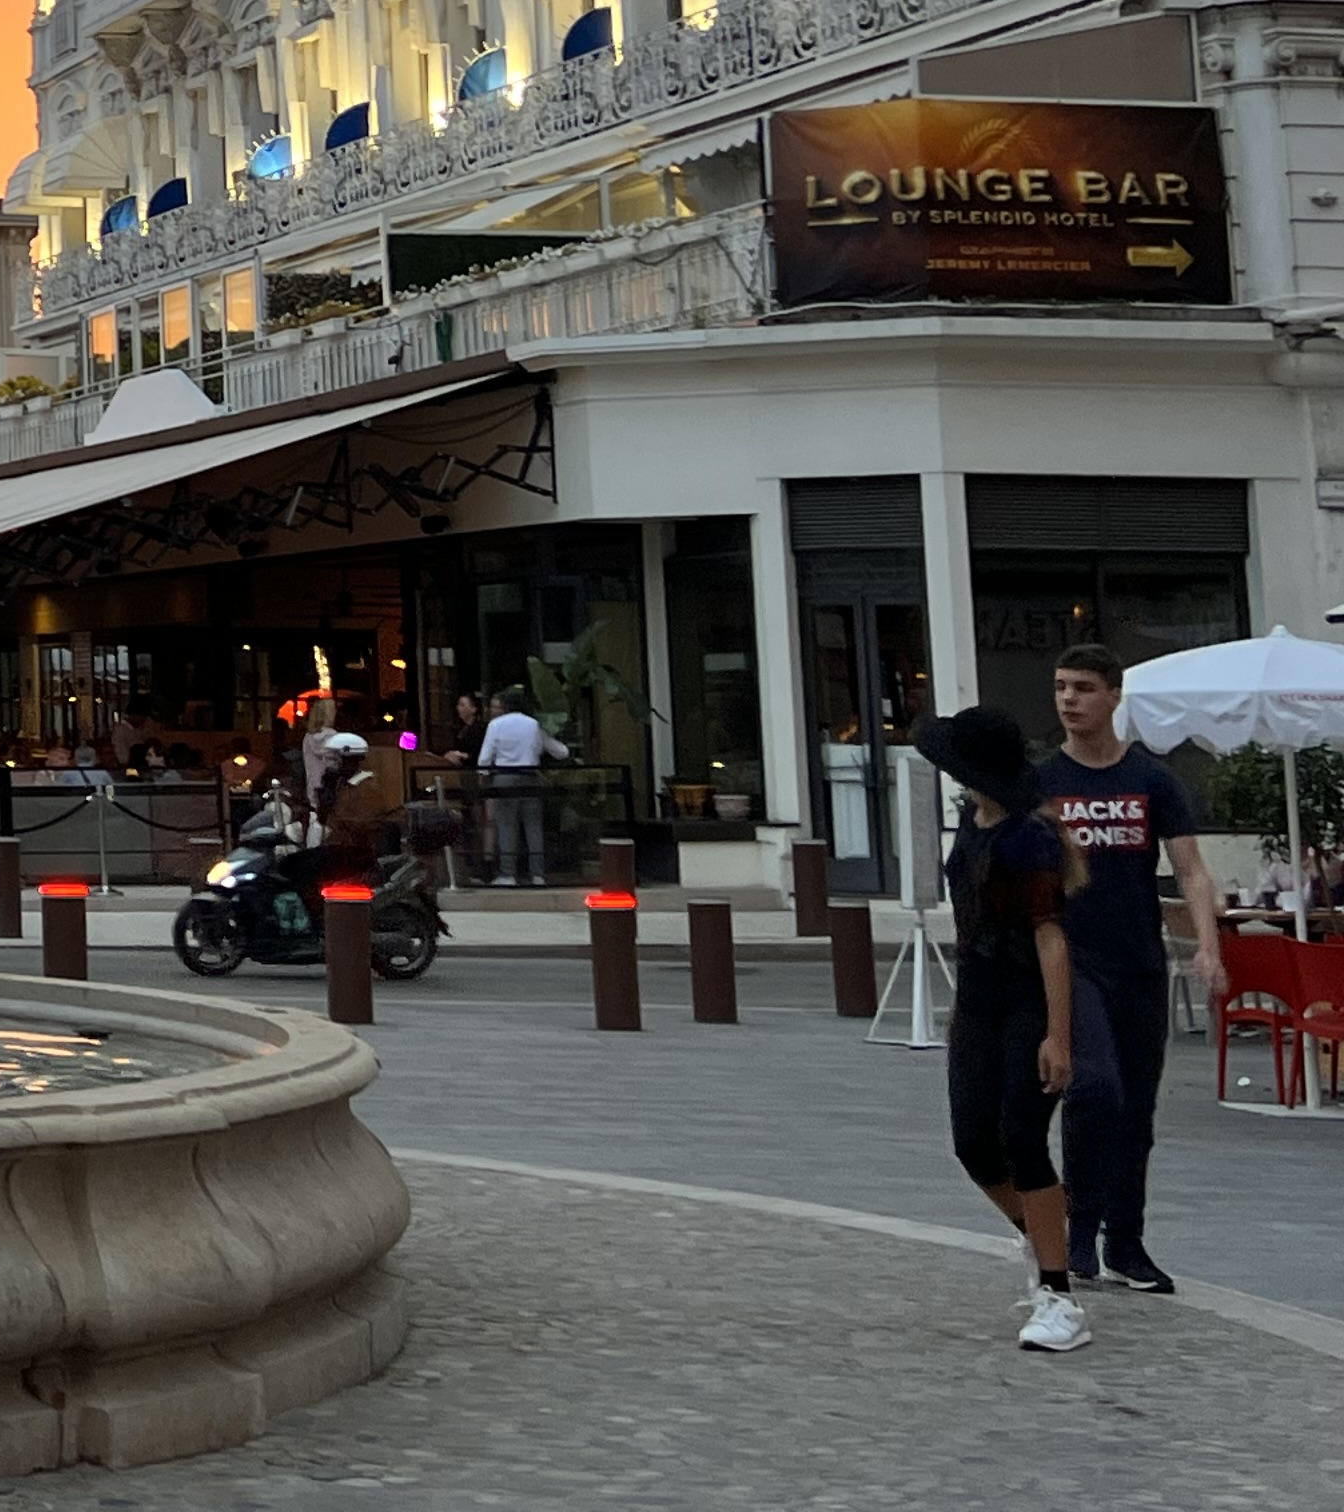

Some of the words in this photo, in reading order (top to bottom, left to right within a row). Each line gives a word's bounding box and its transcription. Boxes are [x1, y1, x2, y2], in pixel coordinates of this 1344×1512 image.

[805, 166, 1052, 208] LOUNGE
[1075, 170, 1190, 206] BAR
[892, 210, 921, 225] BY
[929, 210, 1036, 226] SPLENDID
[1044, 212, 1114, 227] HOTEL
